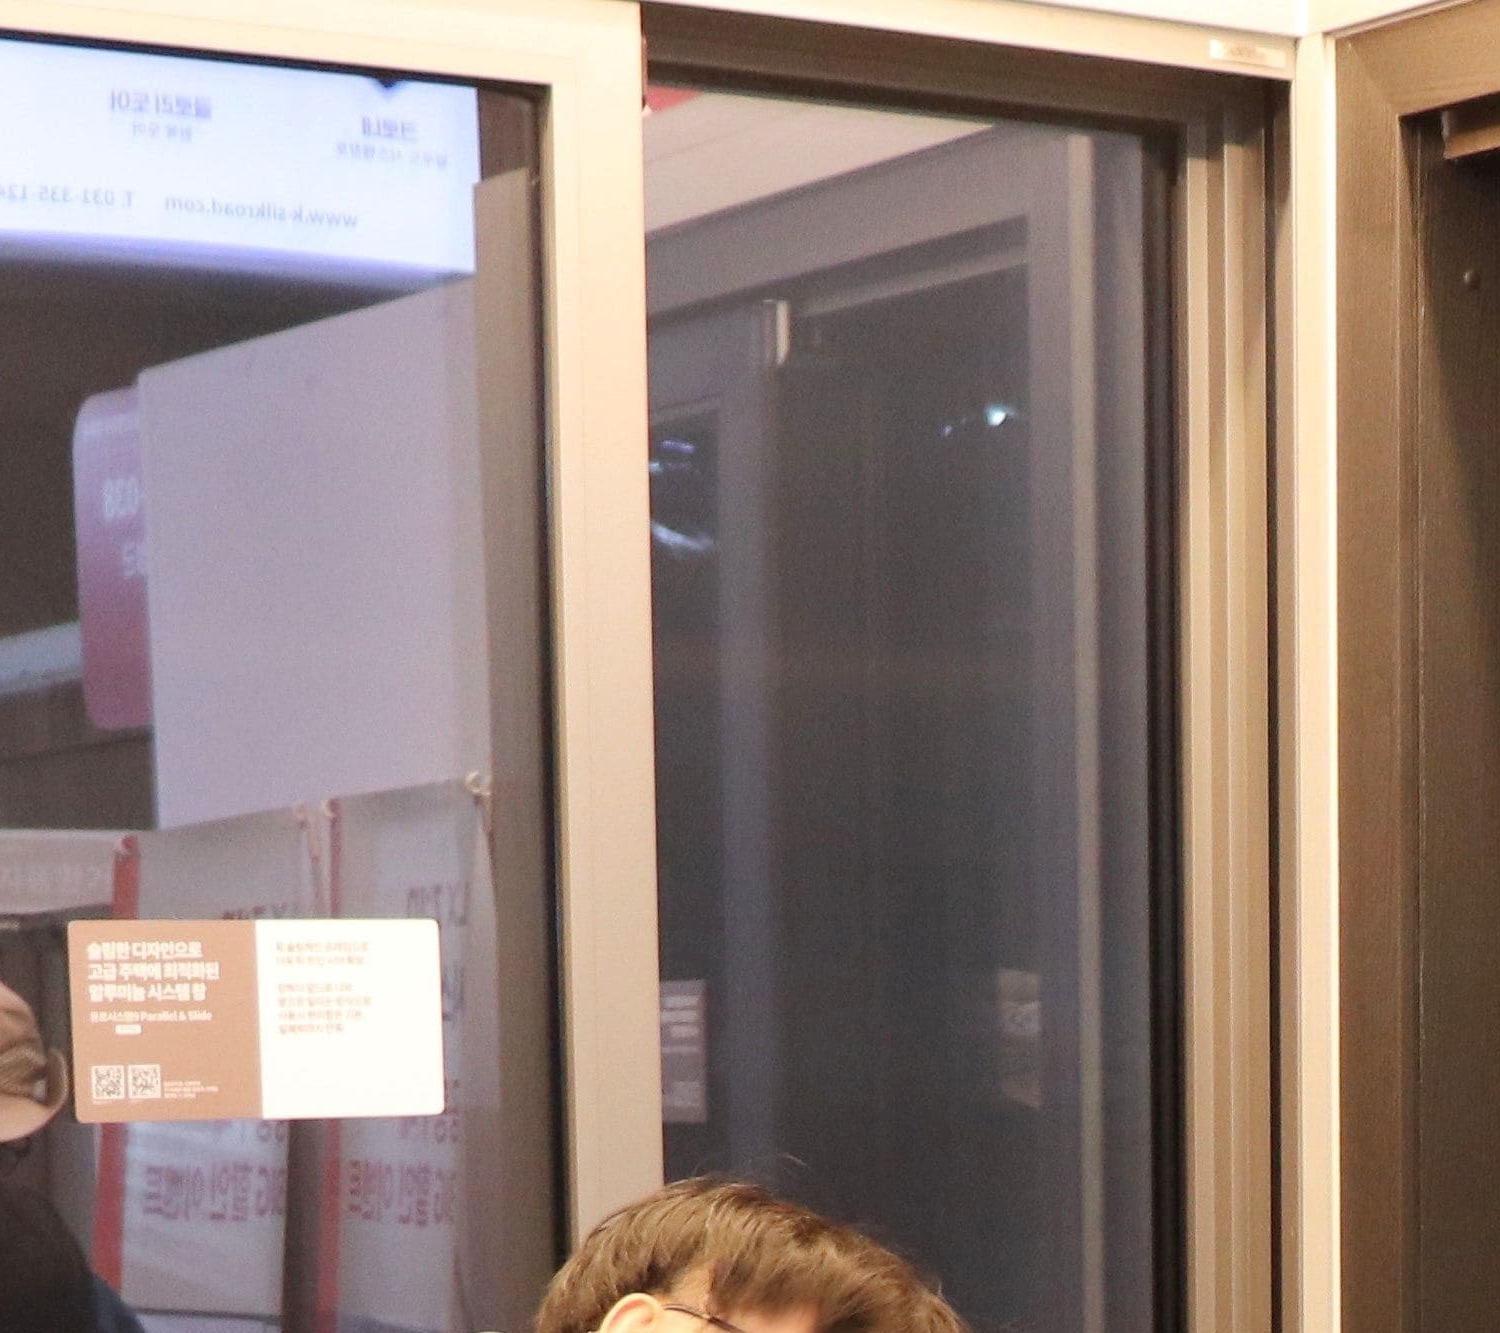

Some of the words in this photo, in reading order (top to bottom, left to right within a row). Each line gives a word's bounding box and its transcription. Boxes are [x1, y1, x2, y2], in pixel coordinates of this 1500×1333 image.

[132, 941, 203, 960] 디자인으로
[88, 963, 117, 981] 고급
[89, 983, 145, 1003] 알루미늄
[147, 984, 191, 1002] 시스템
[140, 1010, 177, 1023] Parallel
[188, 1010, 213, 1022] Slide
